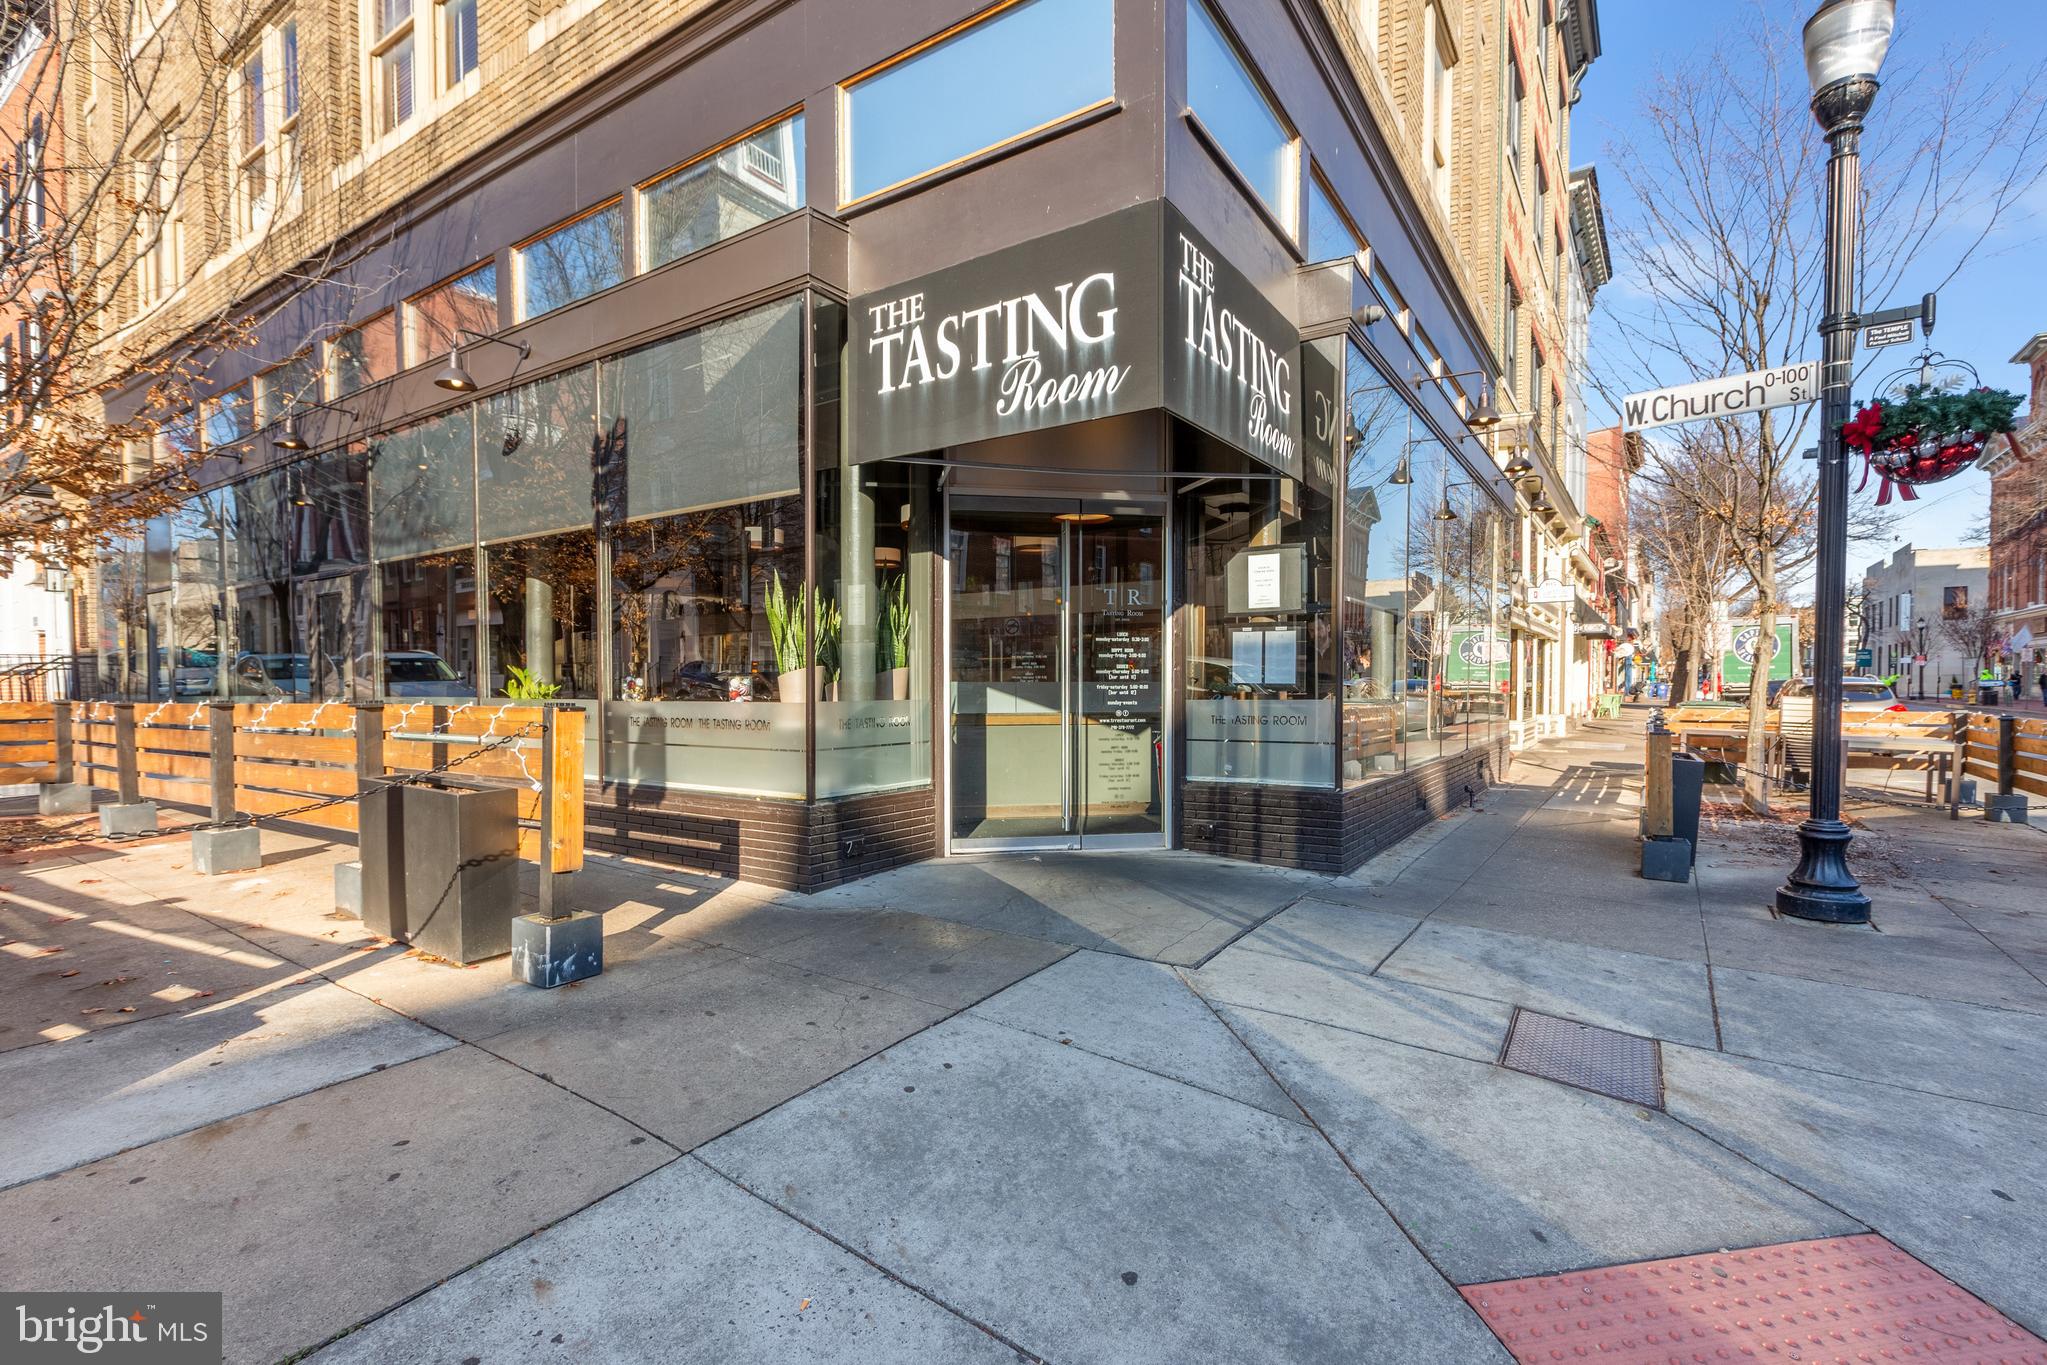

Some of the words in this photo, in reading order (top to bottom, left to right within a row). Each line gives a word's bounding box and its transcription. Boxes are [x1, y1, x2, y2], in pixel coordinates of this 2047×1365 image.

[1179, 232, 1215, 290] THE
[869, 292, 926, 335] THE
[869, 273, 1119, 395] TASTING
[1883, 324, 1909, 333] TEMPLE
[1179, 273, 1292, 415] TASTING
[996, 363, 1132, 416] Room
[1765, 366, 1809, 388] 0-100
[1790, 386, 1808, 402] St
[1625, 398, 1649, 427] W.
[1652, 380, 1766, 422] Church
[1248, 394, 1296, 460] Room
[630, 716, 641, 727] THE
[670, 717, 693, 729] ROOM
[698, 717, 710, 729] THE
[712, 718, 742, 730] TASTING
[745, 719, 771, 731] ROOM
[1211, 715, 1226, 725] THE
[1272, 715, 1308, 726] ROOM
